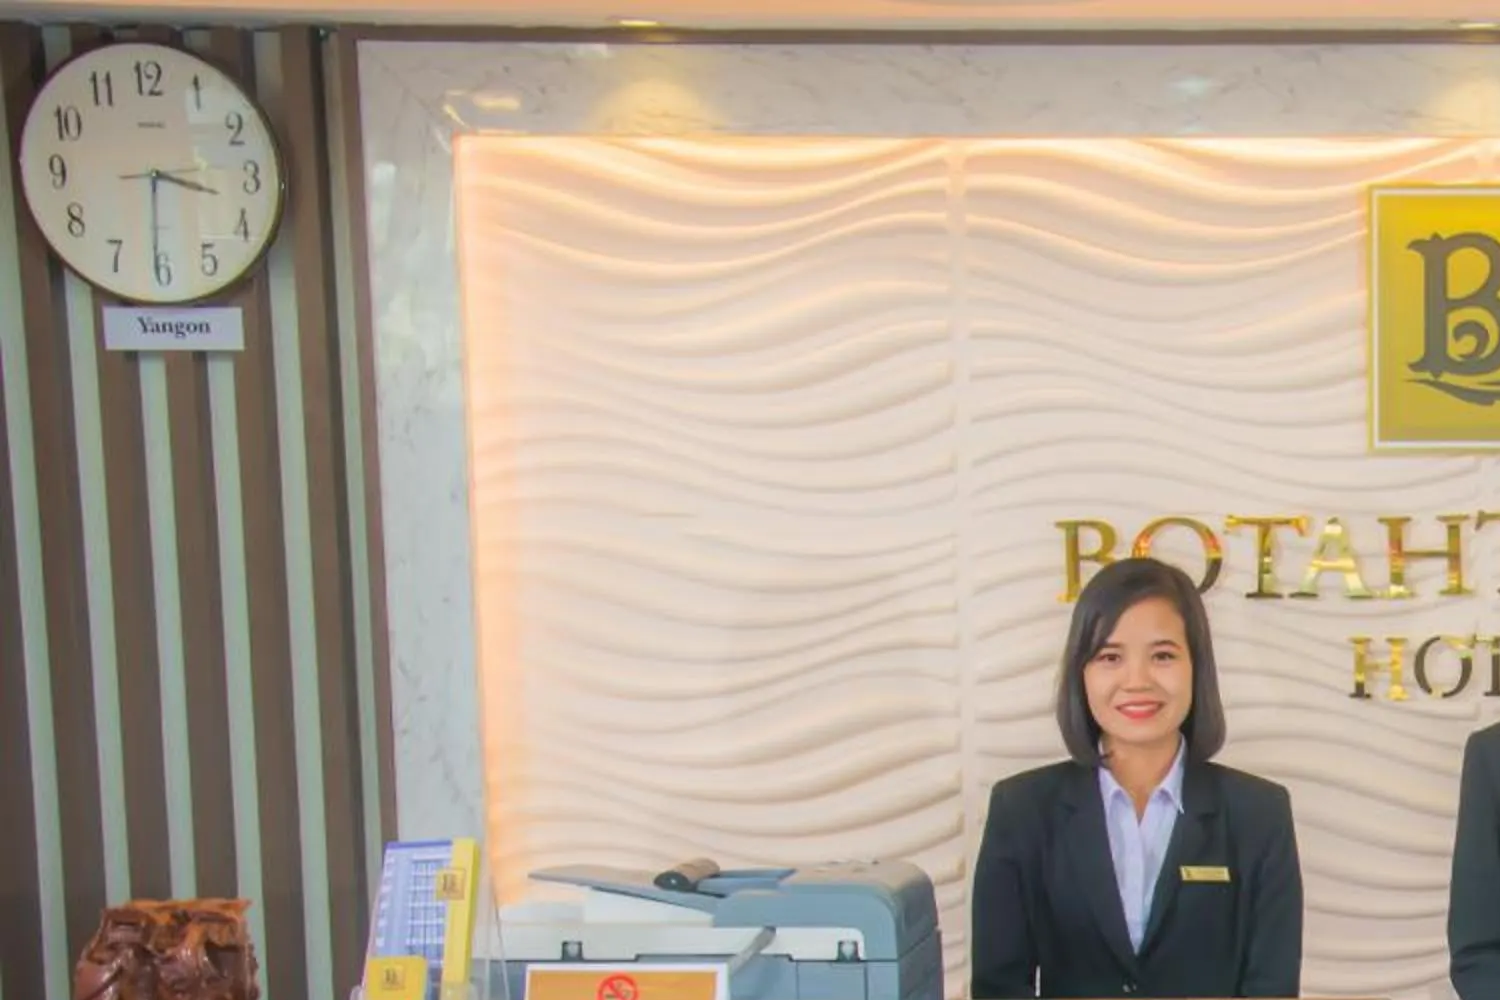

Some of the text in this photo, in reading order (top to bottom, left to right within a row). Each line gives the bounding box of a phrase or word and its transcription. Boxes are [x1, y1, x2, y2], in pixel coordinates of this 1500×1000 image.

[89, 71, 114, 107] 11
[134, 60, 164, 97] 12
[190, 74, 203, 110] 1
[54, 105, 83, 142] 10
[225, 111, 246, 147] 2
[48, 153, 68, 190] 9
[242, 160, 261, 195] 3
[66, 202, 86, 238] 8
[233, 208, 250, 243] 4
[106, 239, 124, 273] 7
[154, 252, 173, 287] 6
[200, 243, 218, 277] 5
[136, 316, 212, 339] Yangon
